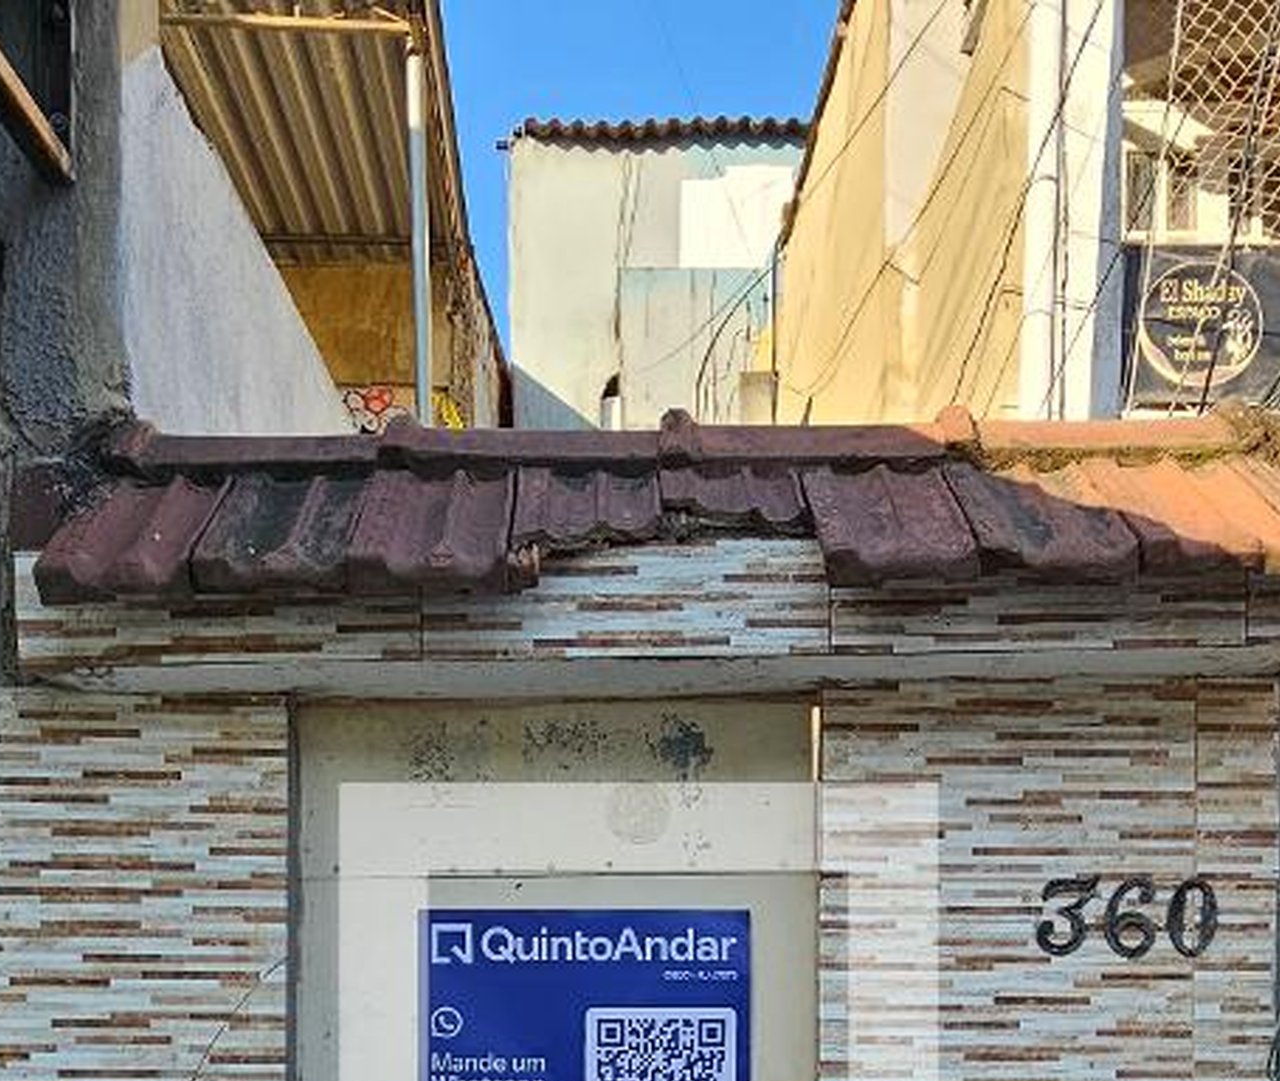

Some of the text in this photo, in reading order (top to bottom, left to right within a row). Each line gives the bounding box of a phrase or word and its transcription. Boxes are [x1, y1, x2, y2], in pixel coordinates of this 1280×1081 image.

[1160, 280, 1178, 302] El
[1036, 874, 1218, 958] 360
[481, 926, 738, 964] QuintoAndar
[431, 1053, 546, 1073] Mande um
